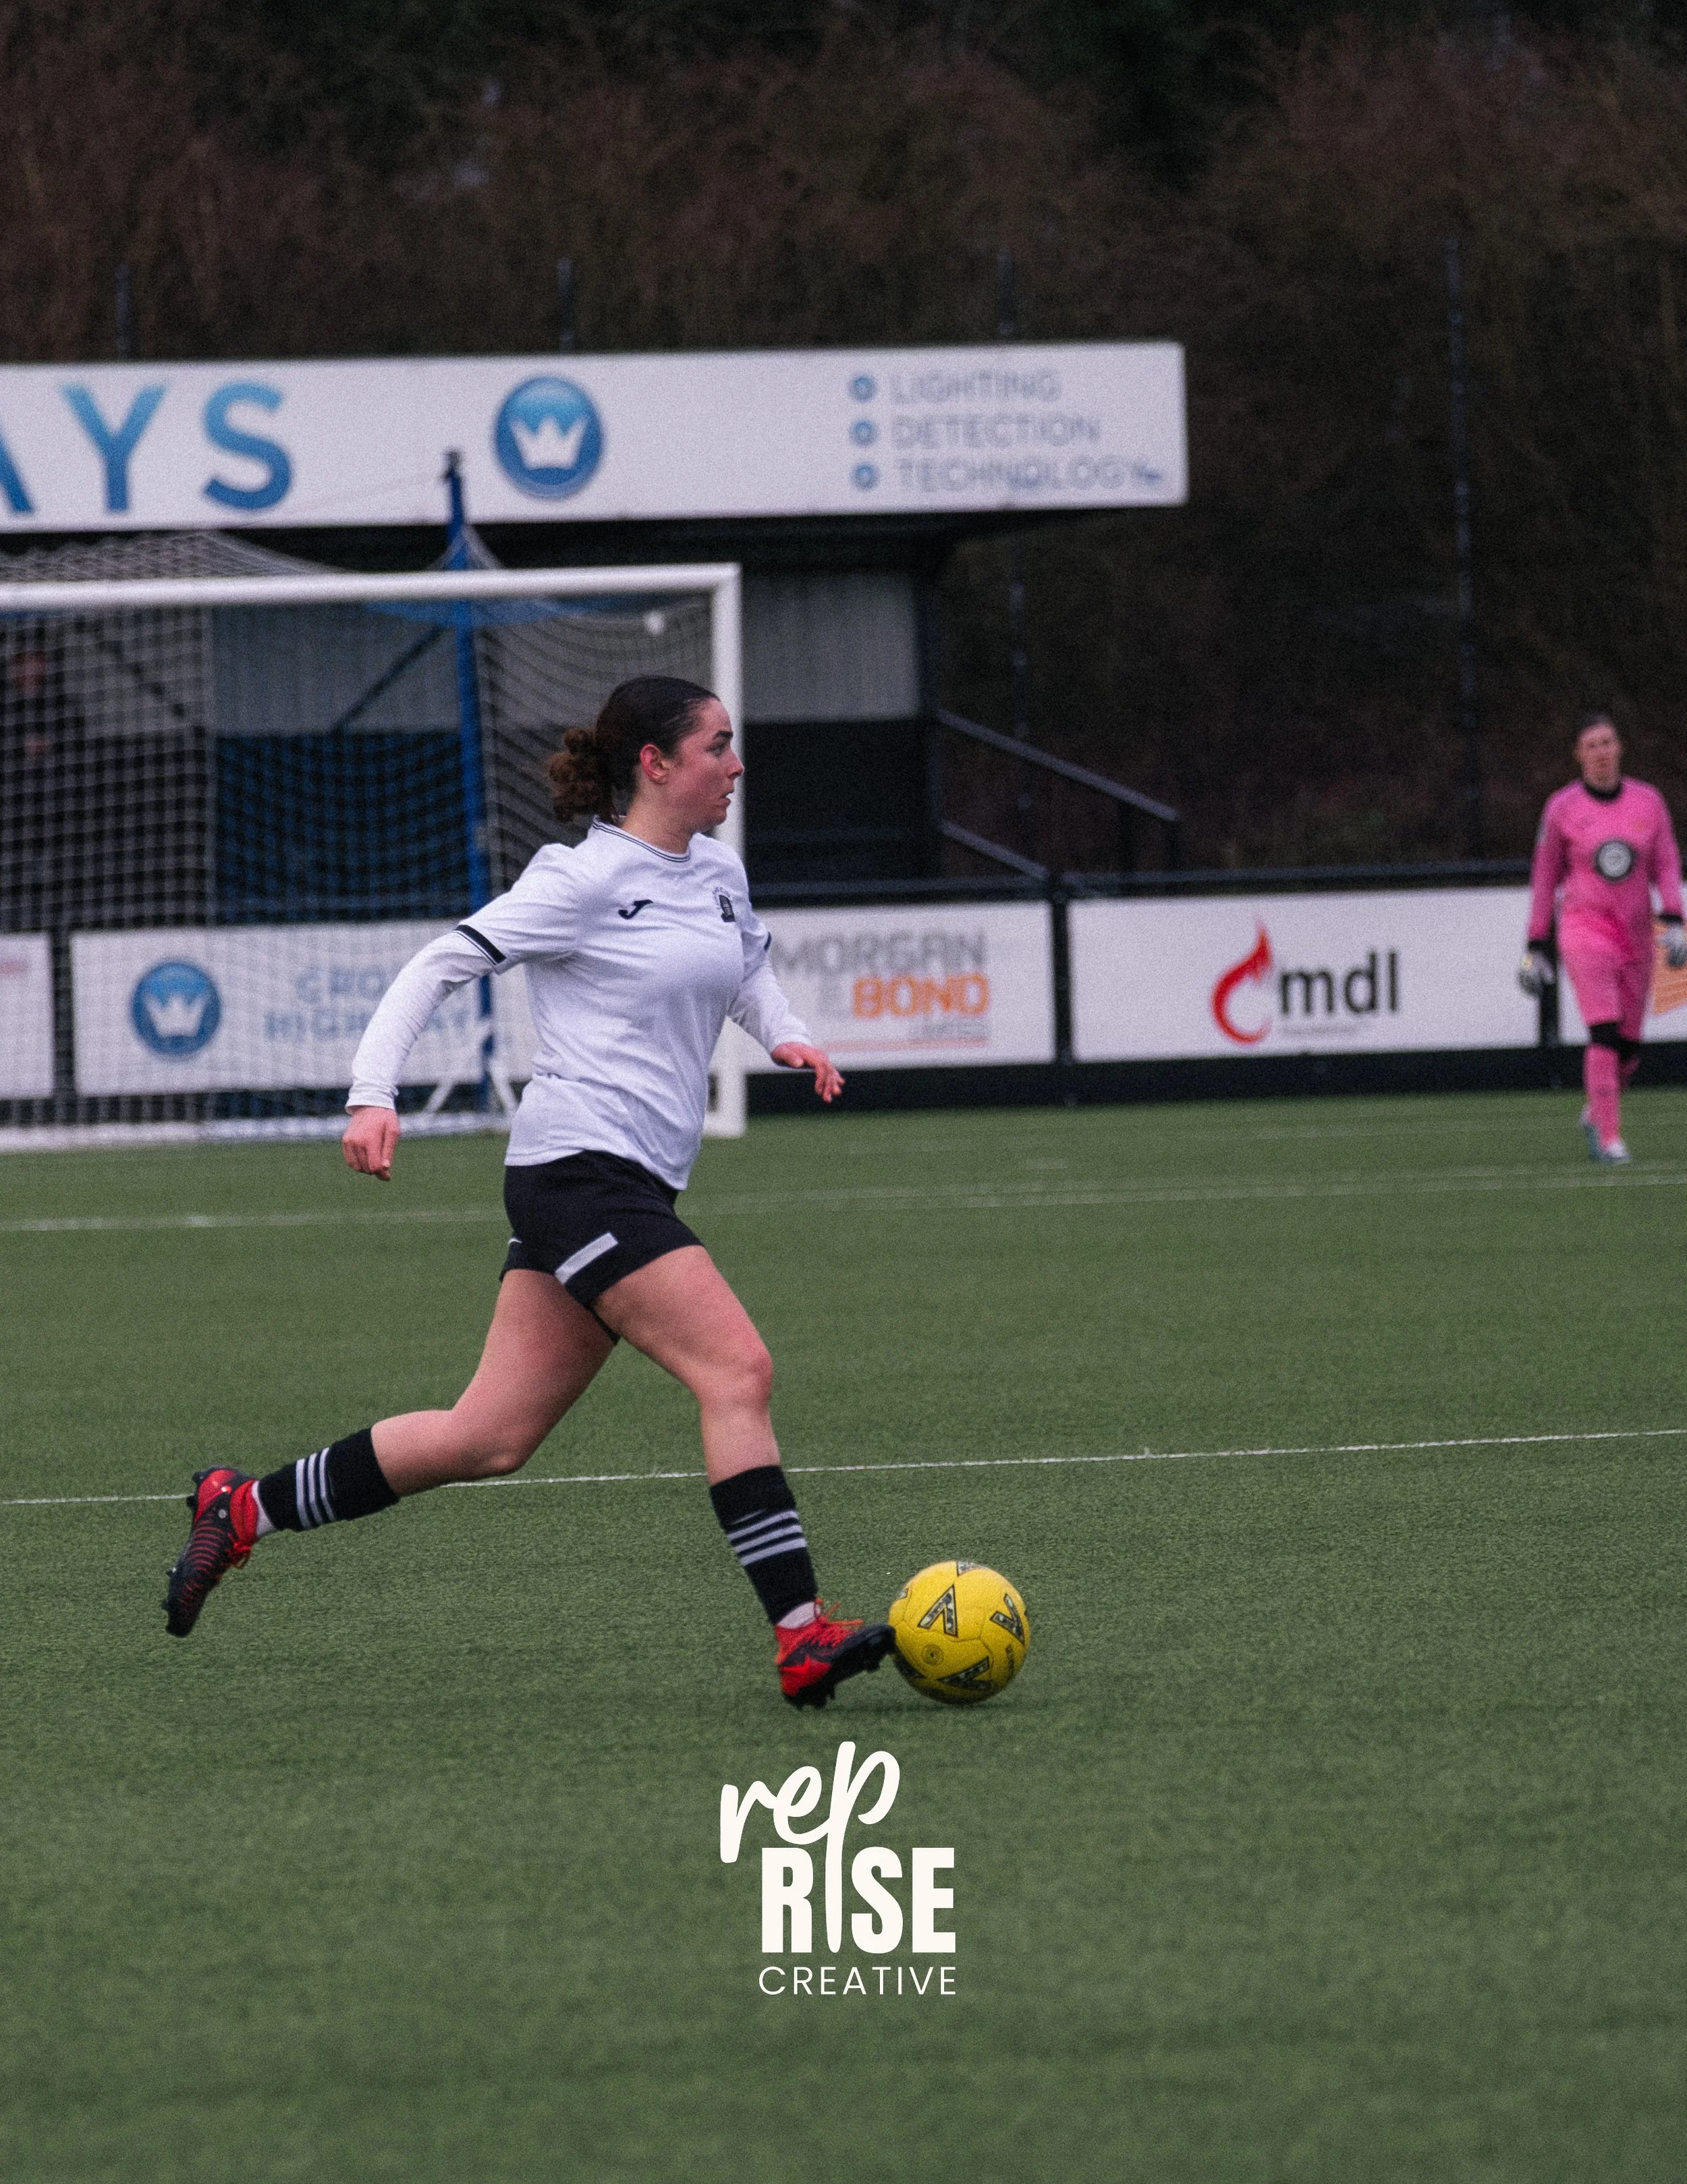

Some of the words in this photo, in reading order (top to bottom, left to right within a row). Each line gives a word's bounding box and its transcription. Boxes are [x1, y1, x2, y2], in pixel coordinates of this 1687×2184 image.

[889, 368, 1063, 404] LIGHTING
[891, 413, 1101, 449] DETECTION
[771, 929, 987, 975] MORGAN
[853, 971, 991, 1020] BOND
[1280, 948, 1398, 1016] mdl
